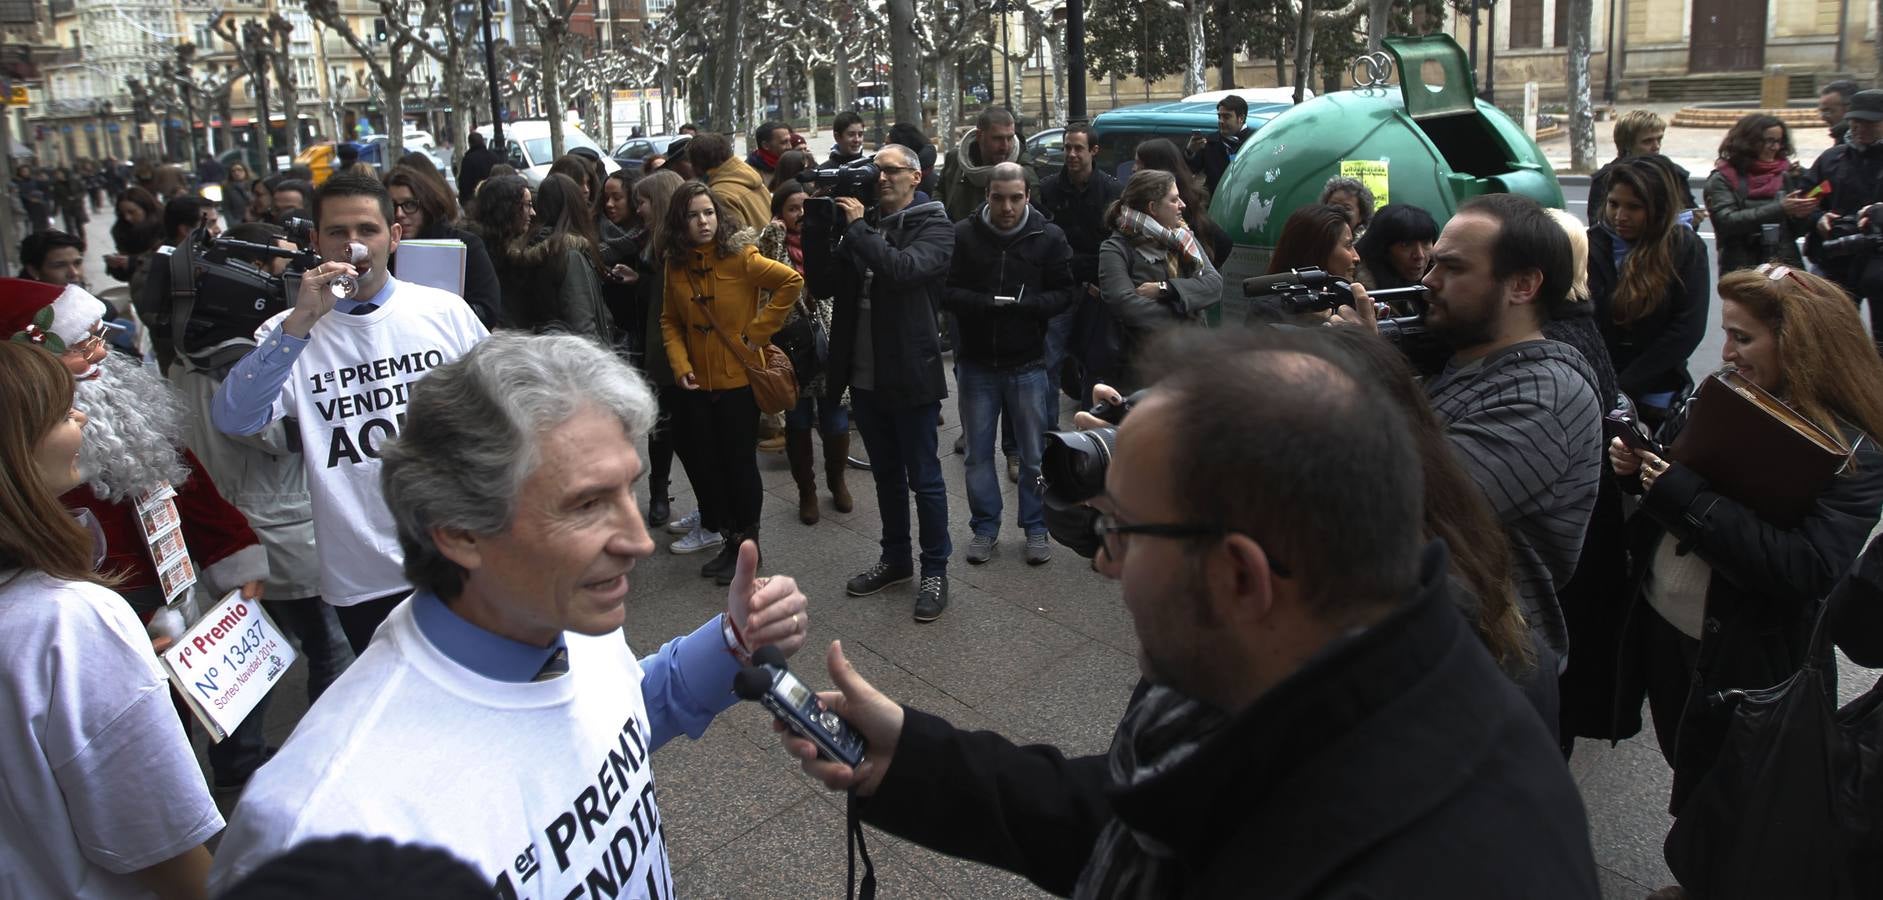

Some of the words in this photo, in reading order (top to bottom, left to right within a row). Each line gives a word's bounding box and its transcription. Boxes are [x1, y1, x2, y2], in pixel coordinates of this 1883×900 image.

[254, 298, 266, 311] 6
[310, 370, 335, 394] 1er
[338, 349, 443, 389] PREMIO
[315, 382, 413, 421] VENDI
[192, 602, 248, 655] Premio
[223, 619, 267, 672] 13437
[214, 683, 240, 710] Sorteo
[236, 657, 262, 686] Navidad
[259, 639, 278, 661] 2014
[545, 711, 647, 873] PREMI
